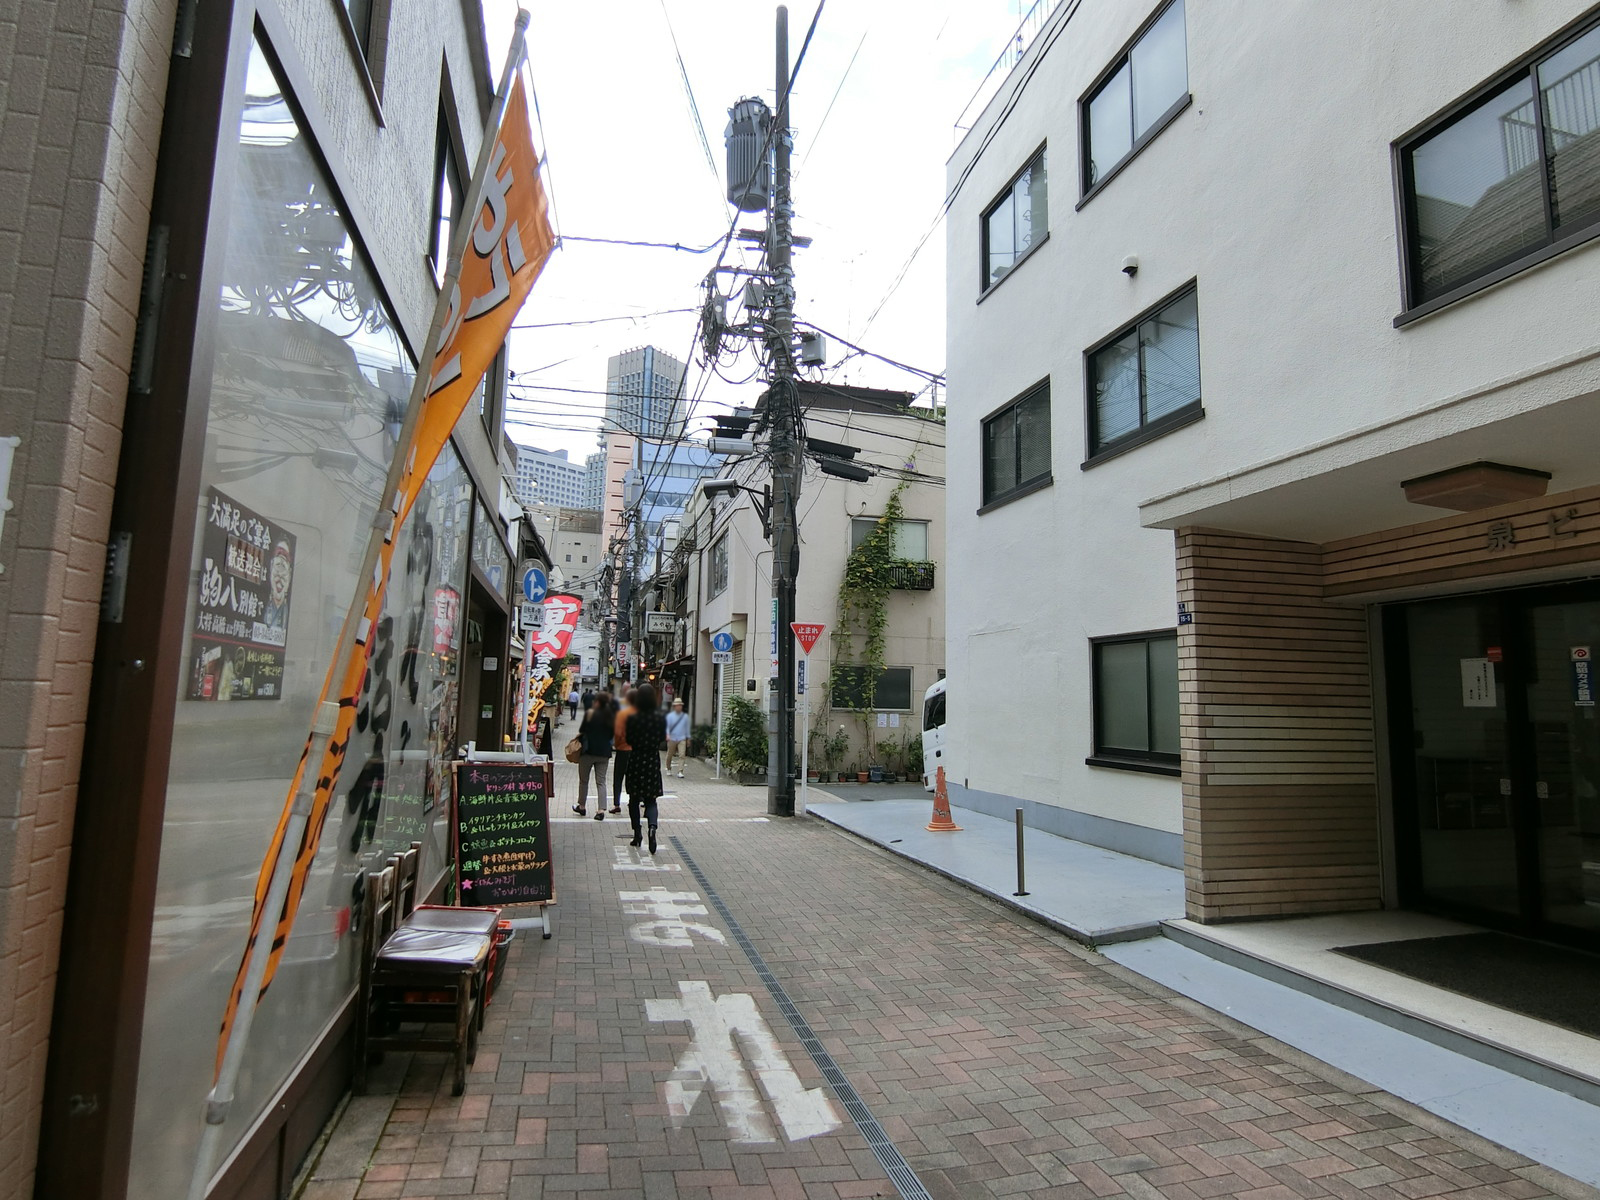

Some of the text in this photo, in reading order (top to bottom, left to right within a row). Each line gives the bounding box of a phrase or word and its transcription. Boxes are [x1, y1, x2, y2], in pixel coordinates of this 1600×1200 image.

[209, 495, 272, 551] 大満足のご宴会
[1487, 508, 1578, 553] 泉ビ
[228, 544, 268, 581] 歓送迎会は
[199, 557, 264, 618] 駒八別館で
[523, 614, 544, 623] 一方通行
[798, 626, 819, 634] 止まれ
[800, 634, 816, 642] STOP
[518, 781, 543, 791] ¥950
